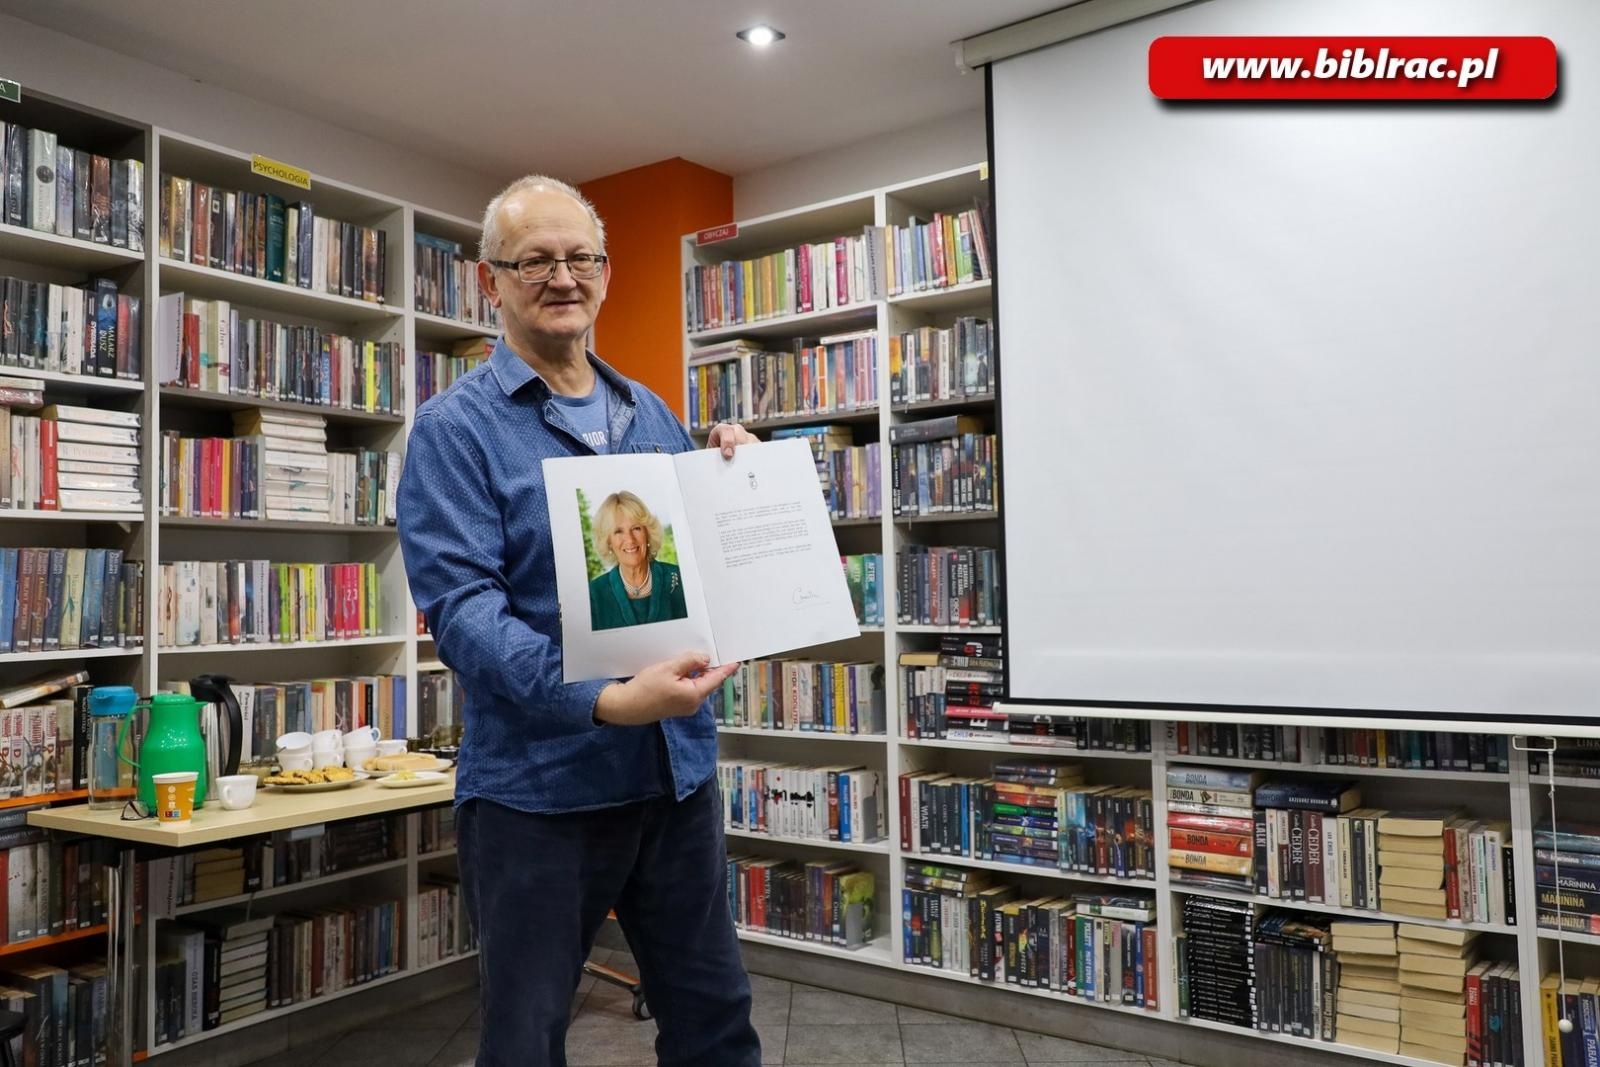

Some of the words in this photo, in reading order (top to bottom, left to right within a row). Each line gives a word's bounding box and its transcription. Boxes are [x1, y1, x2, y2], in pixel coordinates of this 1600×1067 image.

[253, 161, 309, 187] PSYCHOLOGIA
[1185, 773, 1207, 786] BONDA
[1172, 789, 1194, 801] BONDA
[920, 805, 928, 830] WIATR
[1186, 834, 1208, 846] BONDA
[1256, 822, 1266, 847] LALKI
[1292, 827, 1303, 864] CEDER
[1308, 827, 1319, 864] CEDER
[1185, 854, 1207, 865] BONDA
[1557, 880, 1596, 890] MARININA
[1541, 893, 1585, 908] MARININA
